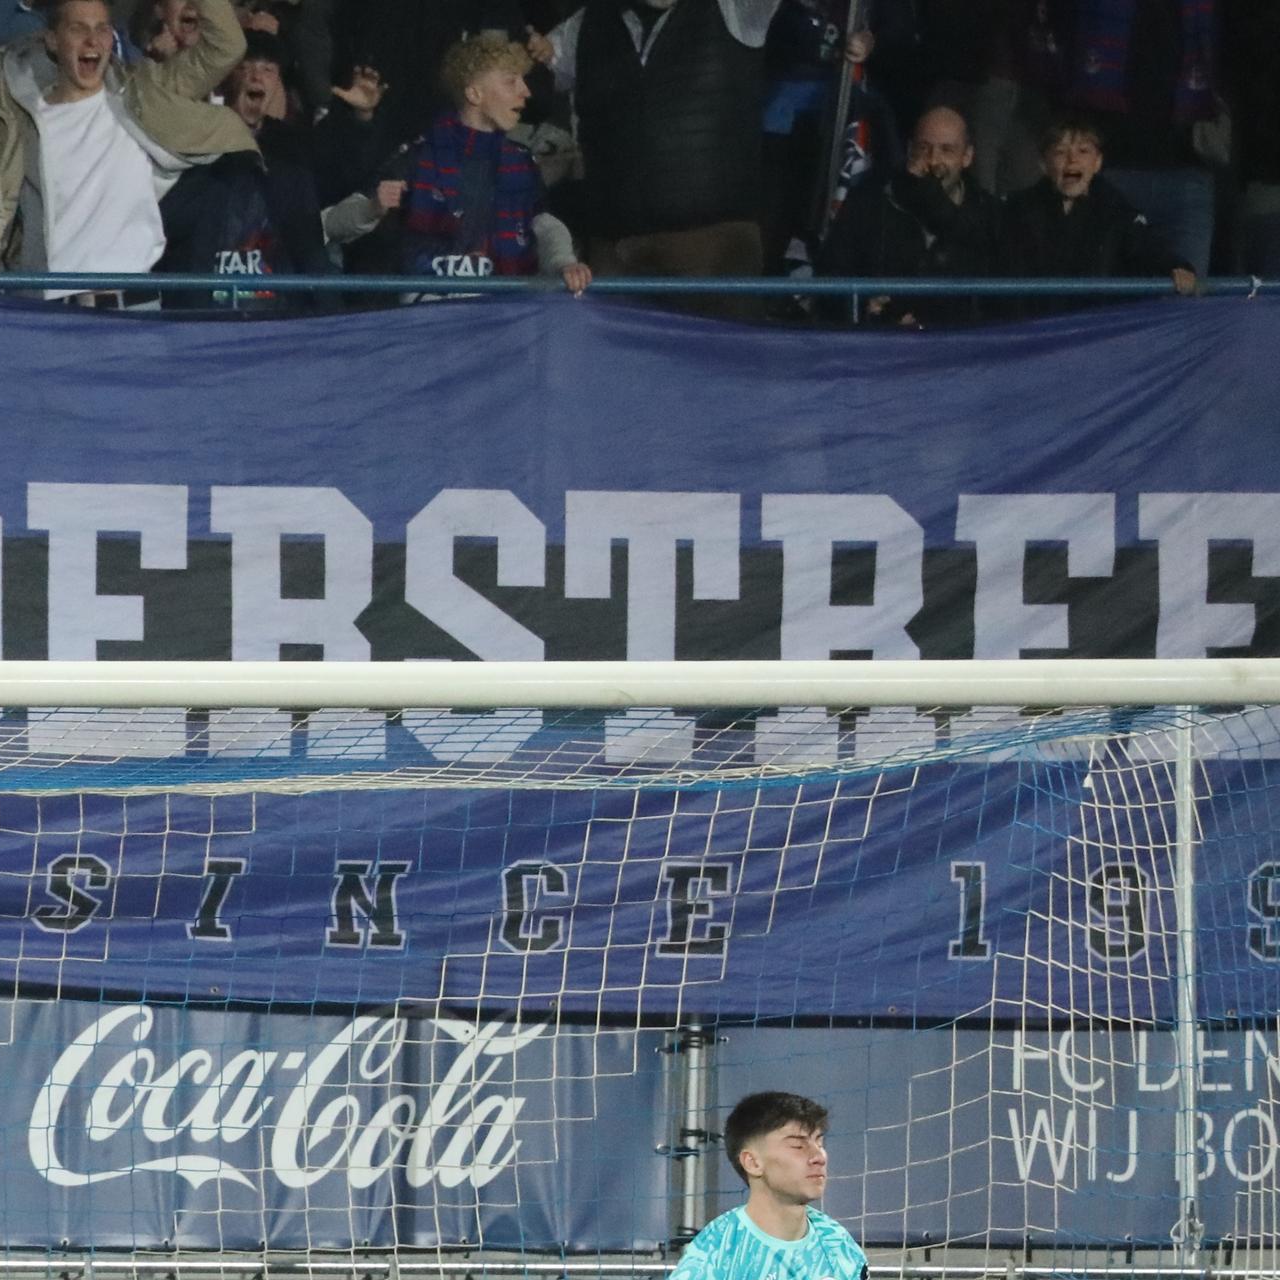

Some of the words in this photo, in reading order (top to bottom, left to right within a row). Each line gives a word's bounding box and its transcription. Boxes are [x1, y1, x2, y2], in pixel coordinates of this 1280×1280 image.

[214, 250, 263, 275] TAR
[30, 852, 734, 959] SINCE
[28, 1004, 548, 1190] Coca-Cola
[1012, 1030, 1106, 1092] FC
[1138, 1030, 1280, 1092] DEN
[1008, 1108, 1138, 1183] WIJ
